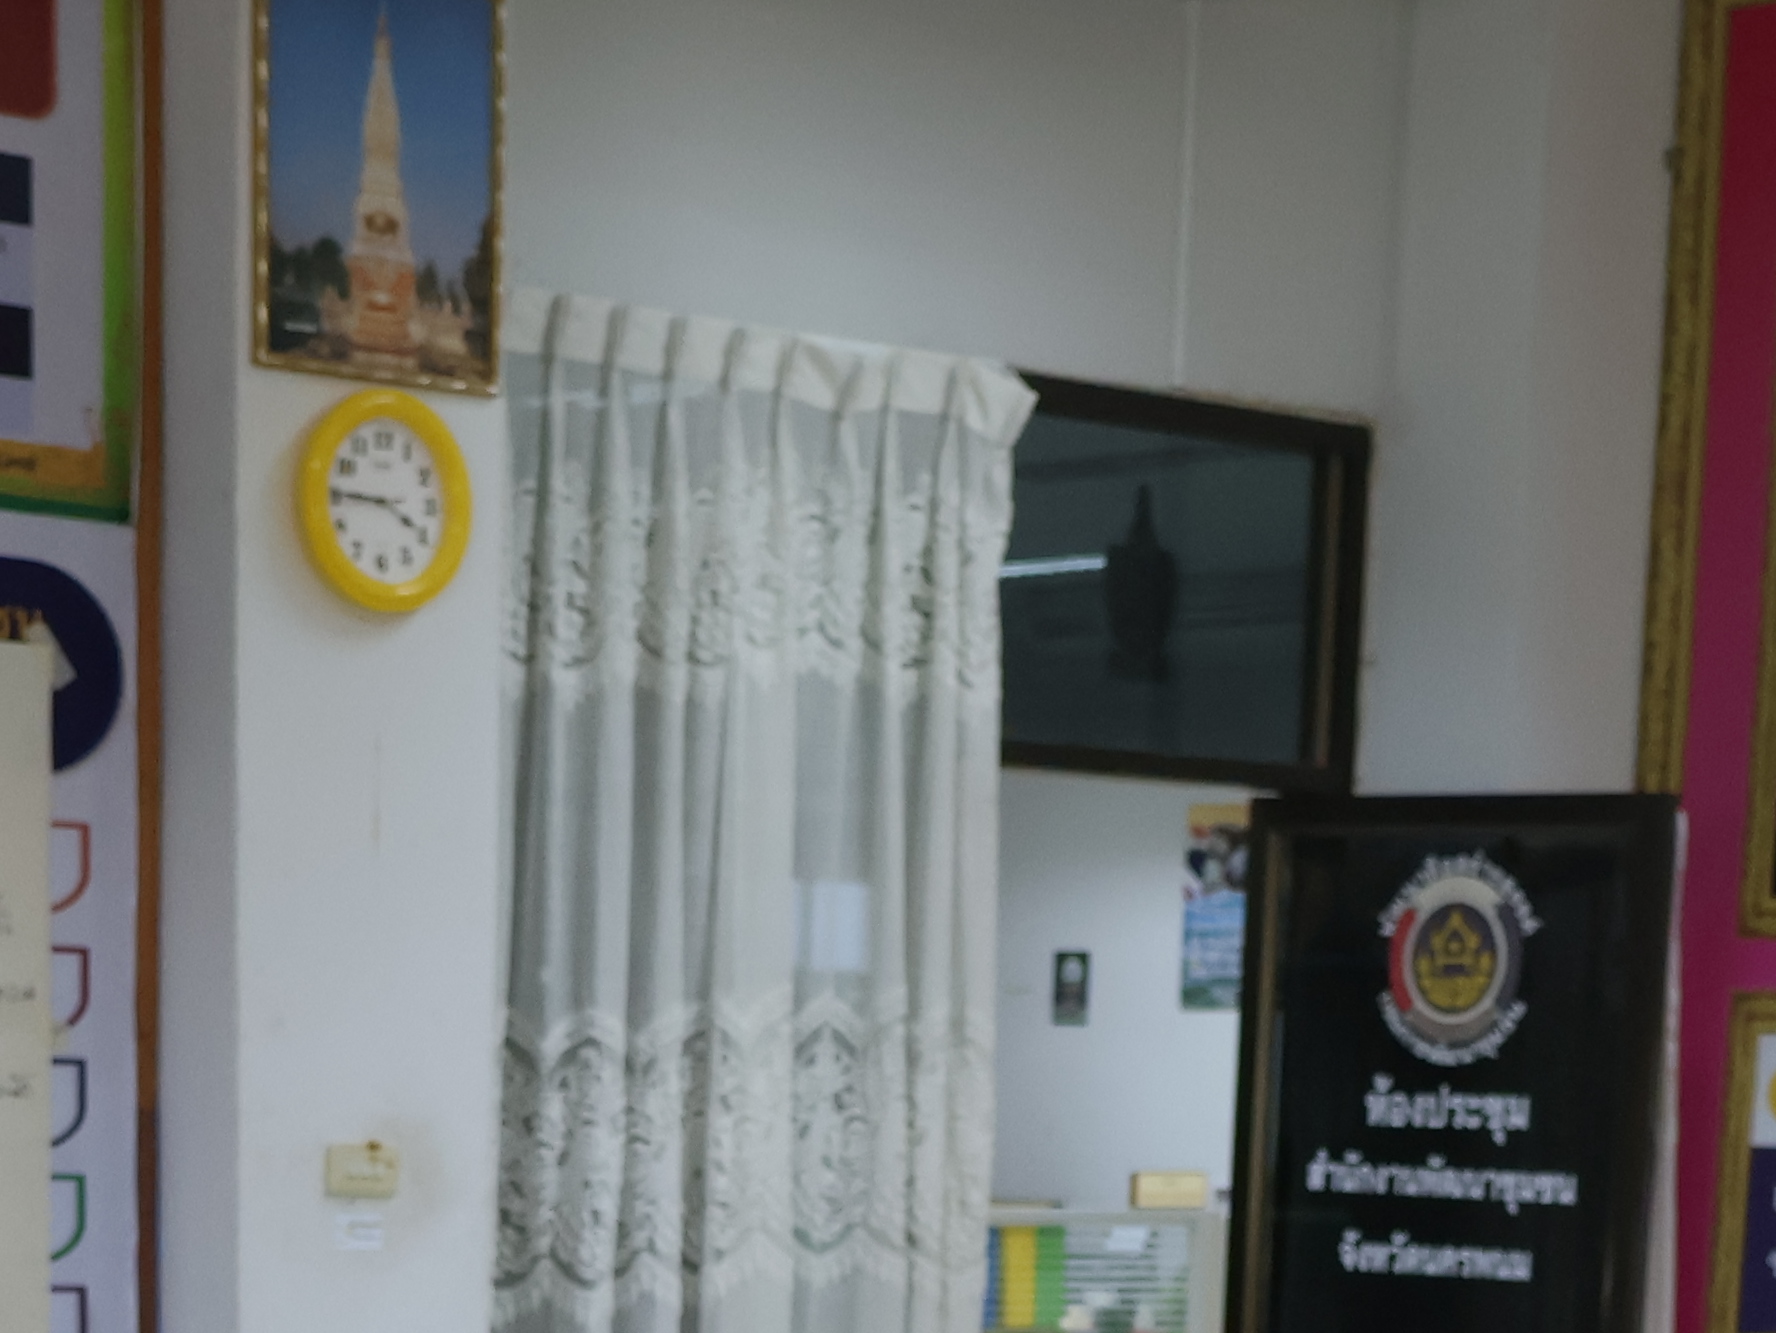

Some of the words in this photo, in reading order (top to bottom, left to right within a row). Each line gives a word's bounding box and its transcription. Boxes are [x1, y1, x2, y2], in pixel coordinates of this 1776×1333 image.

[1364, 1071, 1532, 1147] ห้องประชุม
[1304, 1146, 1580, 1217] สำนักงานพัฒนาชุมชน
